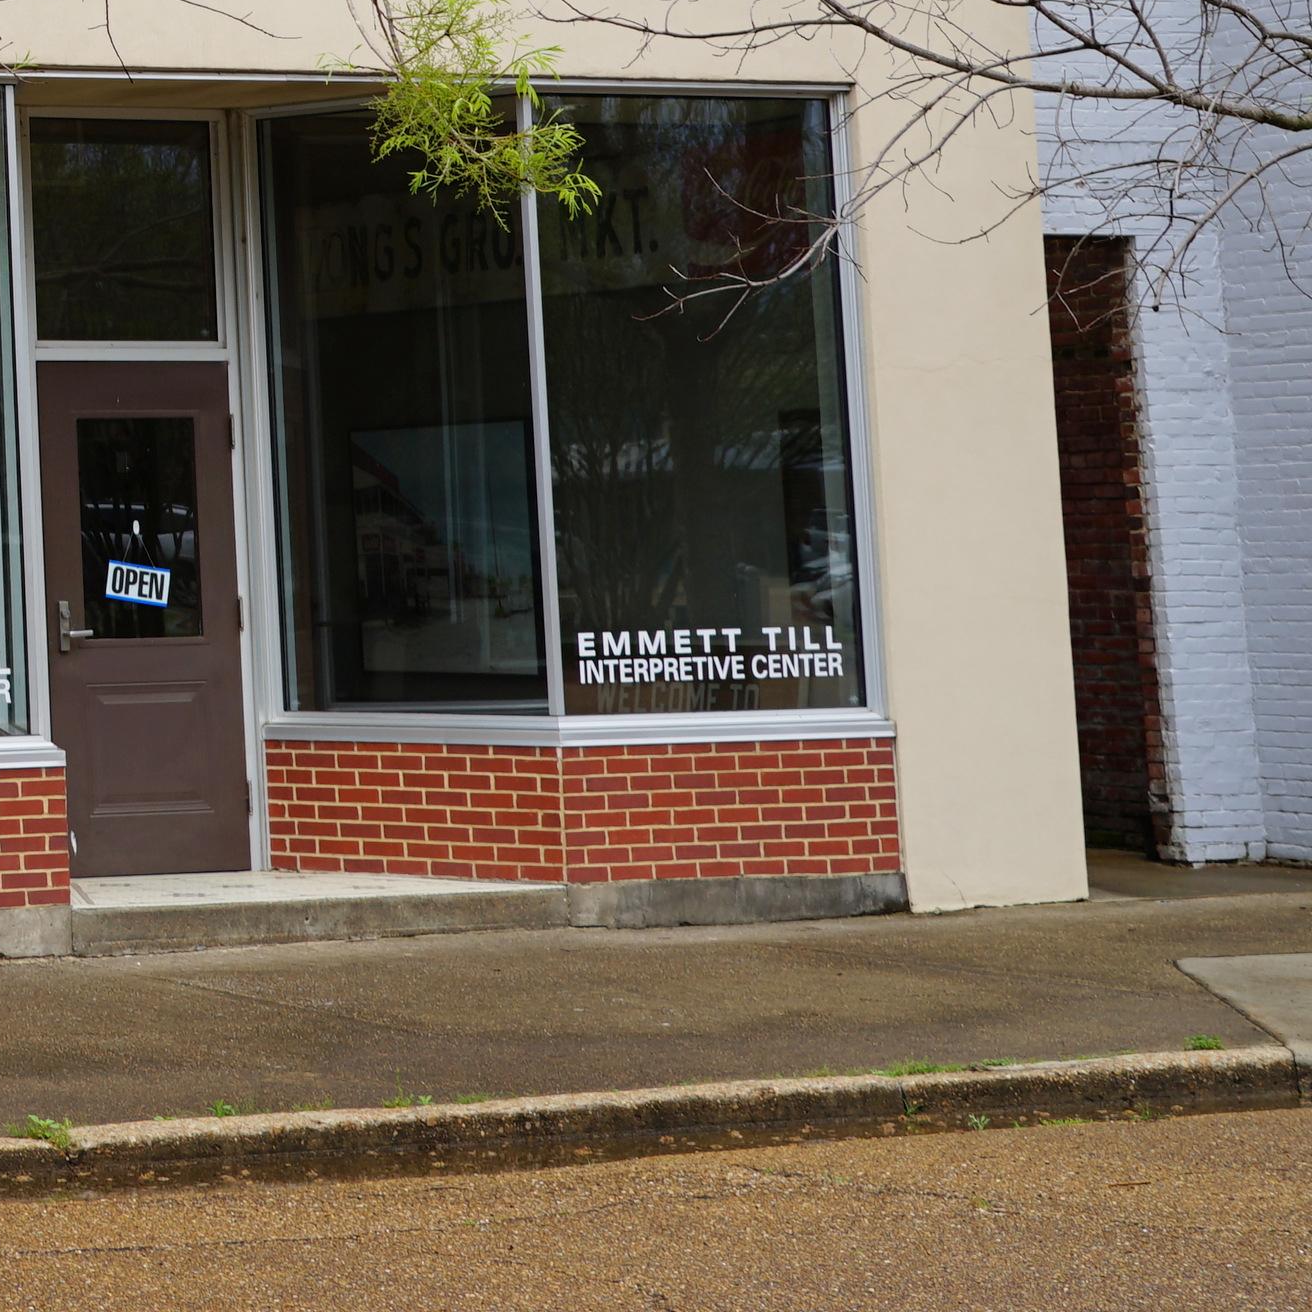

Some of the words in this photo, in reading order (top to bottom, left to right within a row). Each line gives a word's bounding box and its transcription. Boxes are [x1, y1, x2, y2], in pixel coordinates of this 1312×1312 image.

[111, 566, 166, 600] OPEN
[577, 628, 742, 657] EMMETT
[762, 625, 843, 651] TILL
[579, 655, 746, 684] INTERPRETIVE
[751, 652, 844, 679] CENTER
[596, 681, 720, 713] WELCOME
